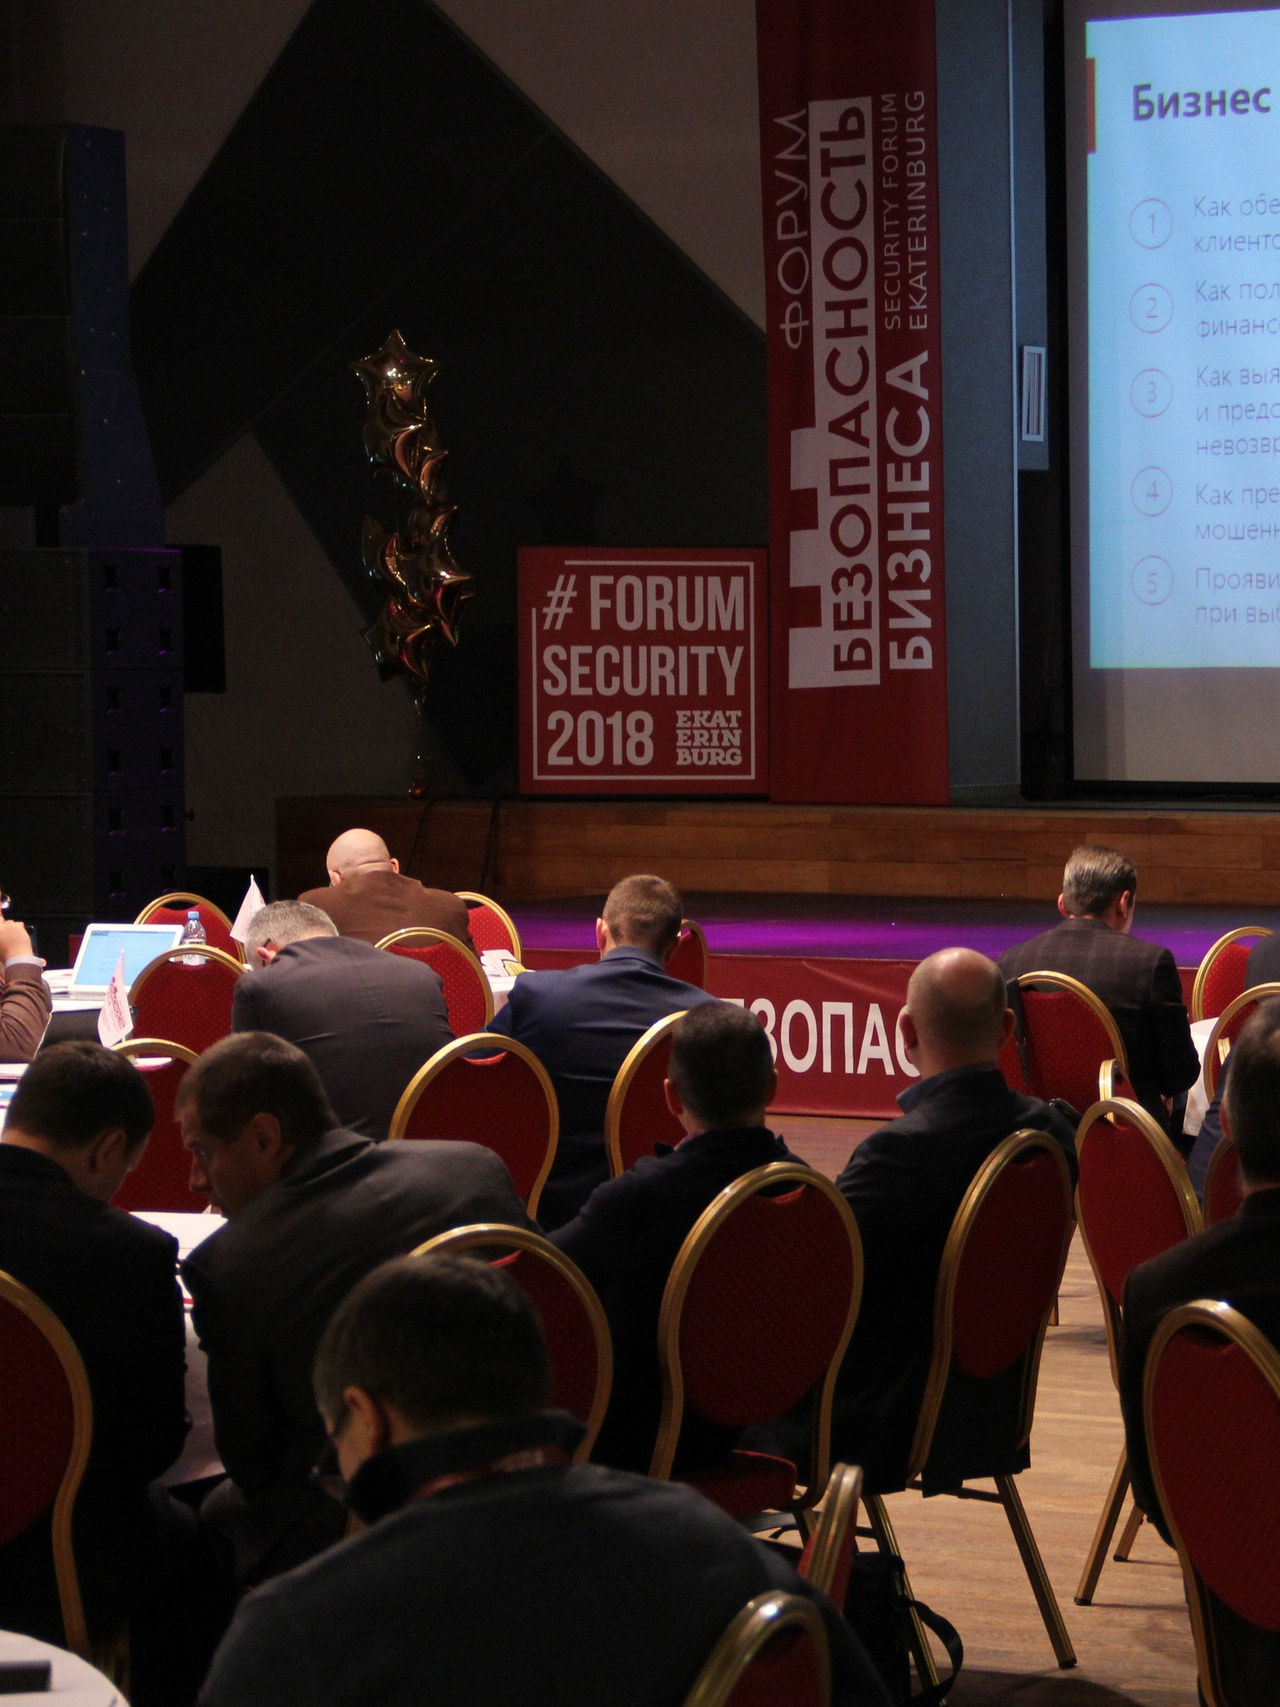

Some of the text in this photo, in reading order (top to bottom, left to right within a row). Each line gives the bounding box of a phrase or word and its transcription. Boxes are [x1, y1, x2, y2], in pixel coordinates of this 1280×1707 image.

[1132, 83, 1271, 121] Бизнес
[881, 93, 900, 331] SECURITY FORUM
[905, 90, 928, 330] EKATERINBURG
[1194, 194, 1232, 217] Как
[1195, 279, 1231, 303] Как
[1145, 297, 1159, 319] 2
[1196, 364, 1232, 388] Как
[819, 105, 873, 672] БЕЗОПАСНОСТЬ
[1146, 380, 1158, 403] 3
[1196, 405, 1209, 422] и
[1146, 479, 1159, 501] 4
[1195, 482, 1234, 506] Как
[884, 350, 933, 670] БИЗНЕСА
[1146, 572, 1158, 594] 5
[1195, 604, 1238, 629] при
[542, 644, 745, 697] SECURITY
[675, 710, 743, 728] EKAT
[546, 709, 655, 767] 2018
[675, 729, 743, 747] ERIN
[675, 748, 743, 766] BURG
